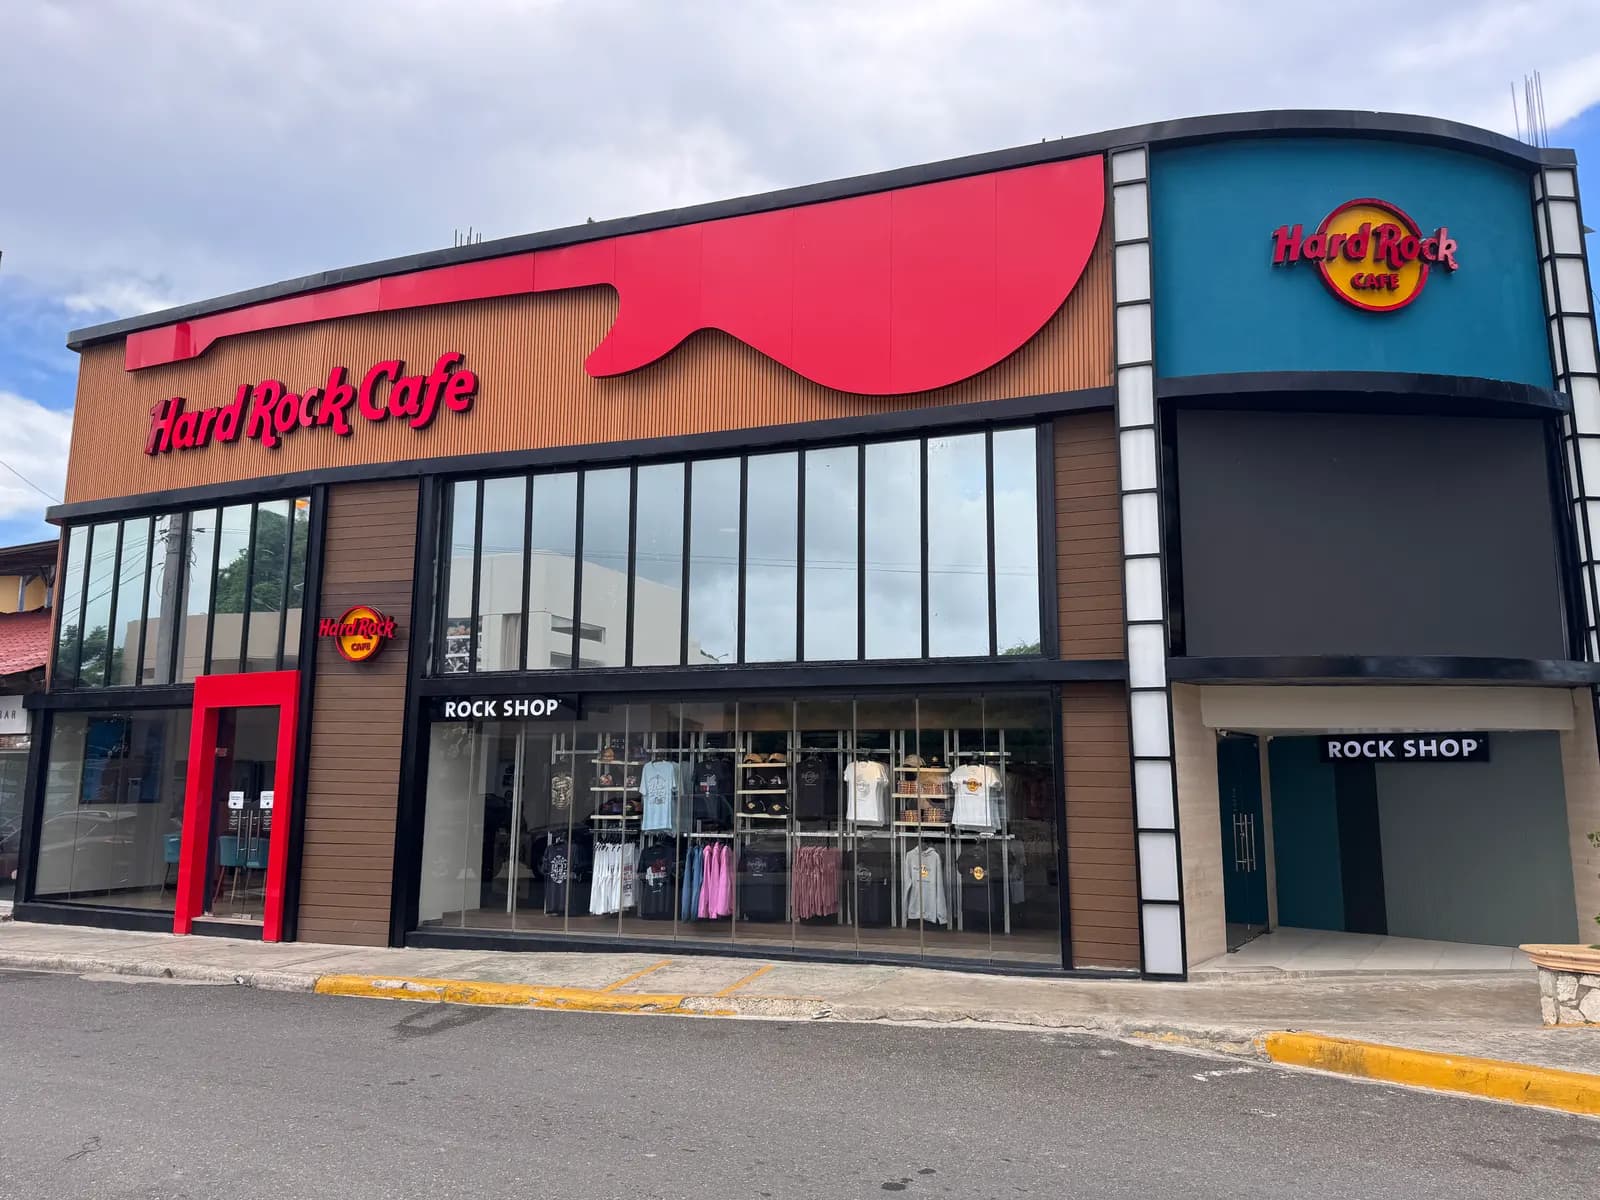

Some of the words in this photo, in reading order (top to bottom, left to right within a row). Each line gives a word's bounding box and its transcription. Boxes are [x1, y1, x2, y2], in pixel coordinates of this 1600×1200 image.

[1272, 222, 1372, 264] Hard
[1372, 223, 1459, 271] Rock
[1351, 272, 1400, 290] CAFE
[145, 384, 252, 455] Hard
[246, 366, 357, 448] Rock
[359, 351, 478, 430] Cafe
[319, 617, 357, 637] Hard
[357, 616, 396, 639] Rock
[351, 643, 371, 652] CAFE
[445, 701, 497, 718] ROCK
[503, 699, 558, 717] SHOP
[1328, 740, 1395, 758] ROCK
[1403, 739, 1478, 757] SHOP
